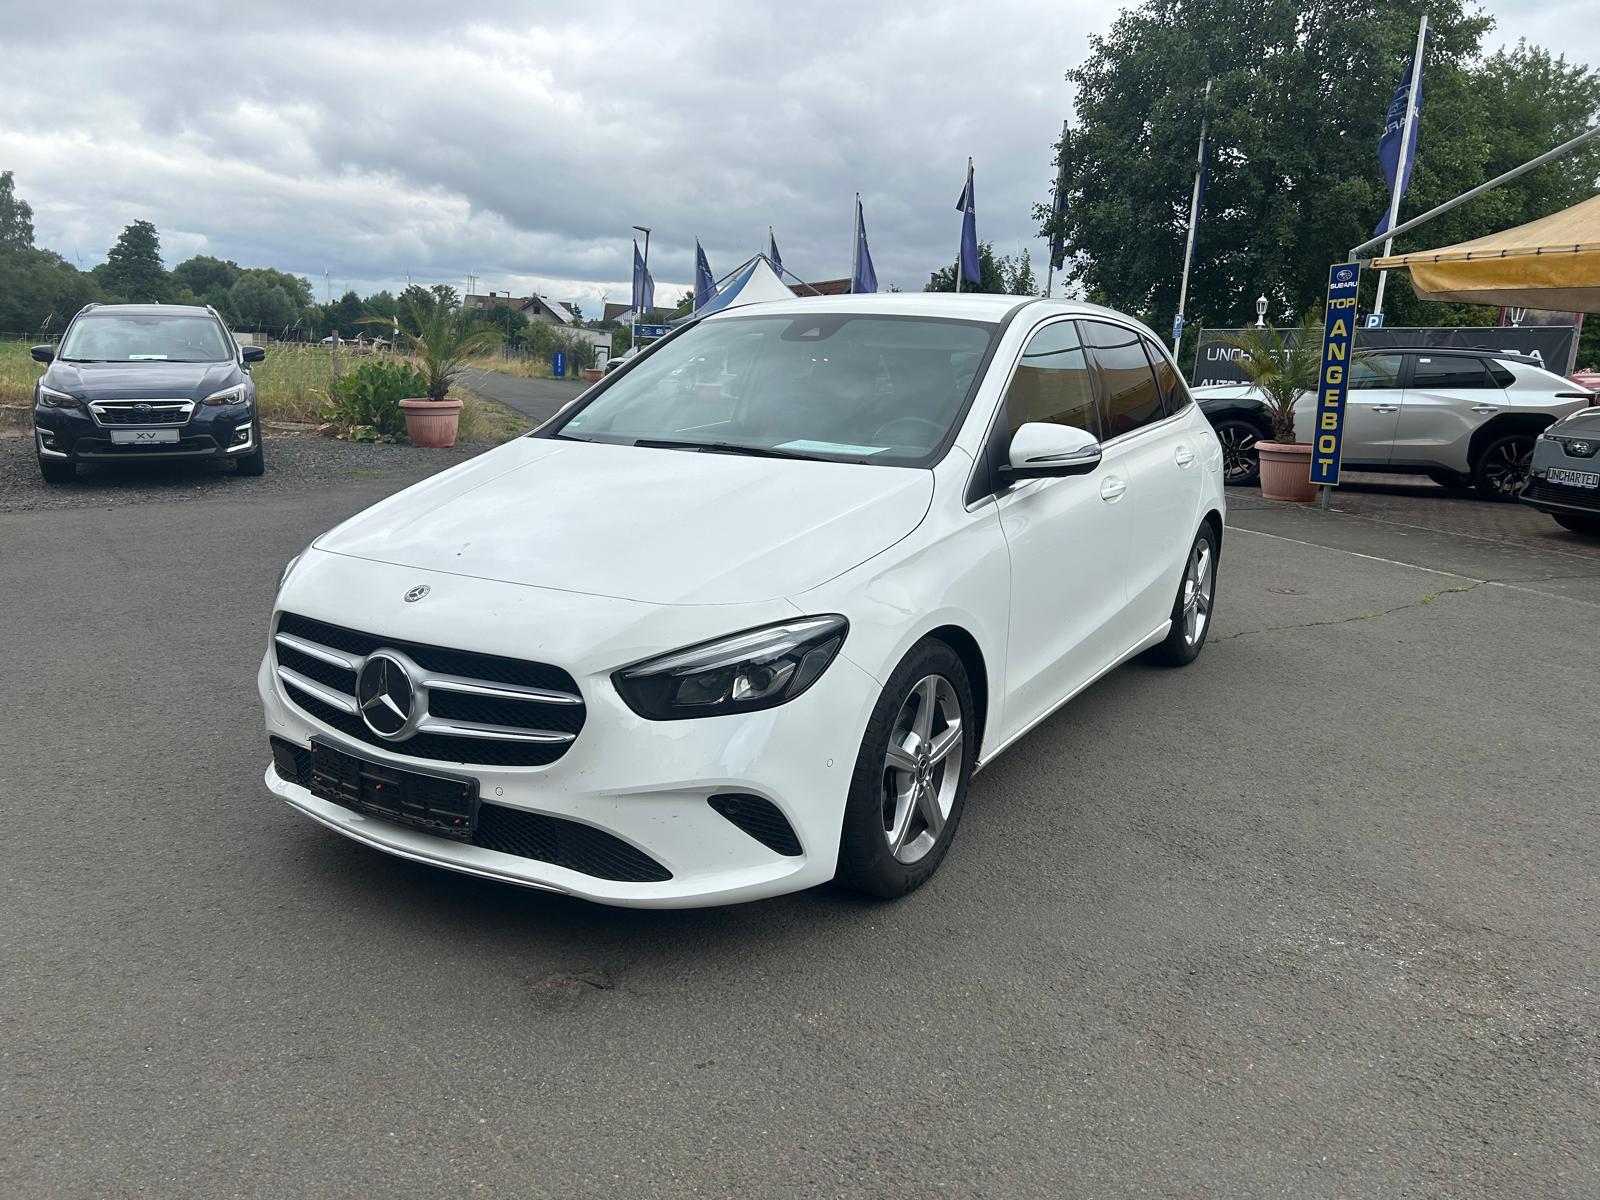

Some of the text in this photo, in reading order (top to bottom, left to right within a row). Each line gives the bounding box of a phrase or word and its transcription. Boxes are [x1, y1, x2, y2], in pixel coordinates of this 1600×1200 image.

[1330, 281, 1358, 289] SUBARU
[1328, 297, 1356, 310] TOP
[1367, 316, 1380, 328] P
[1318, 318, 1348, 477] ANGEBOT
[1548, 470, 1599, 485] UNCHARTED
